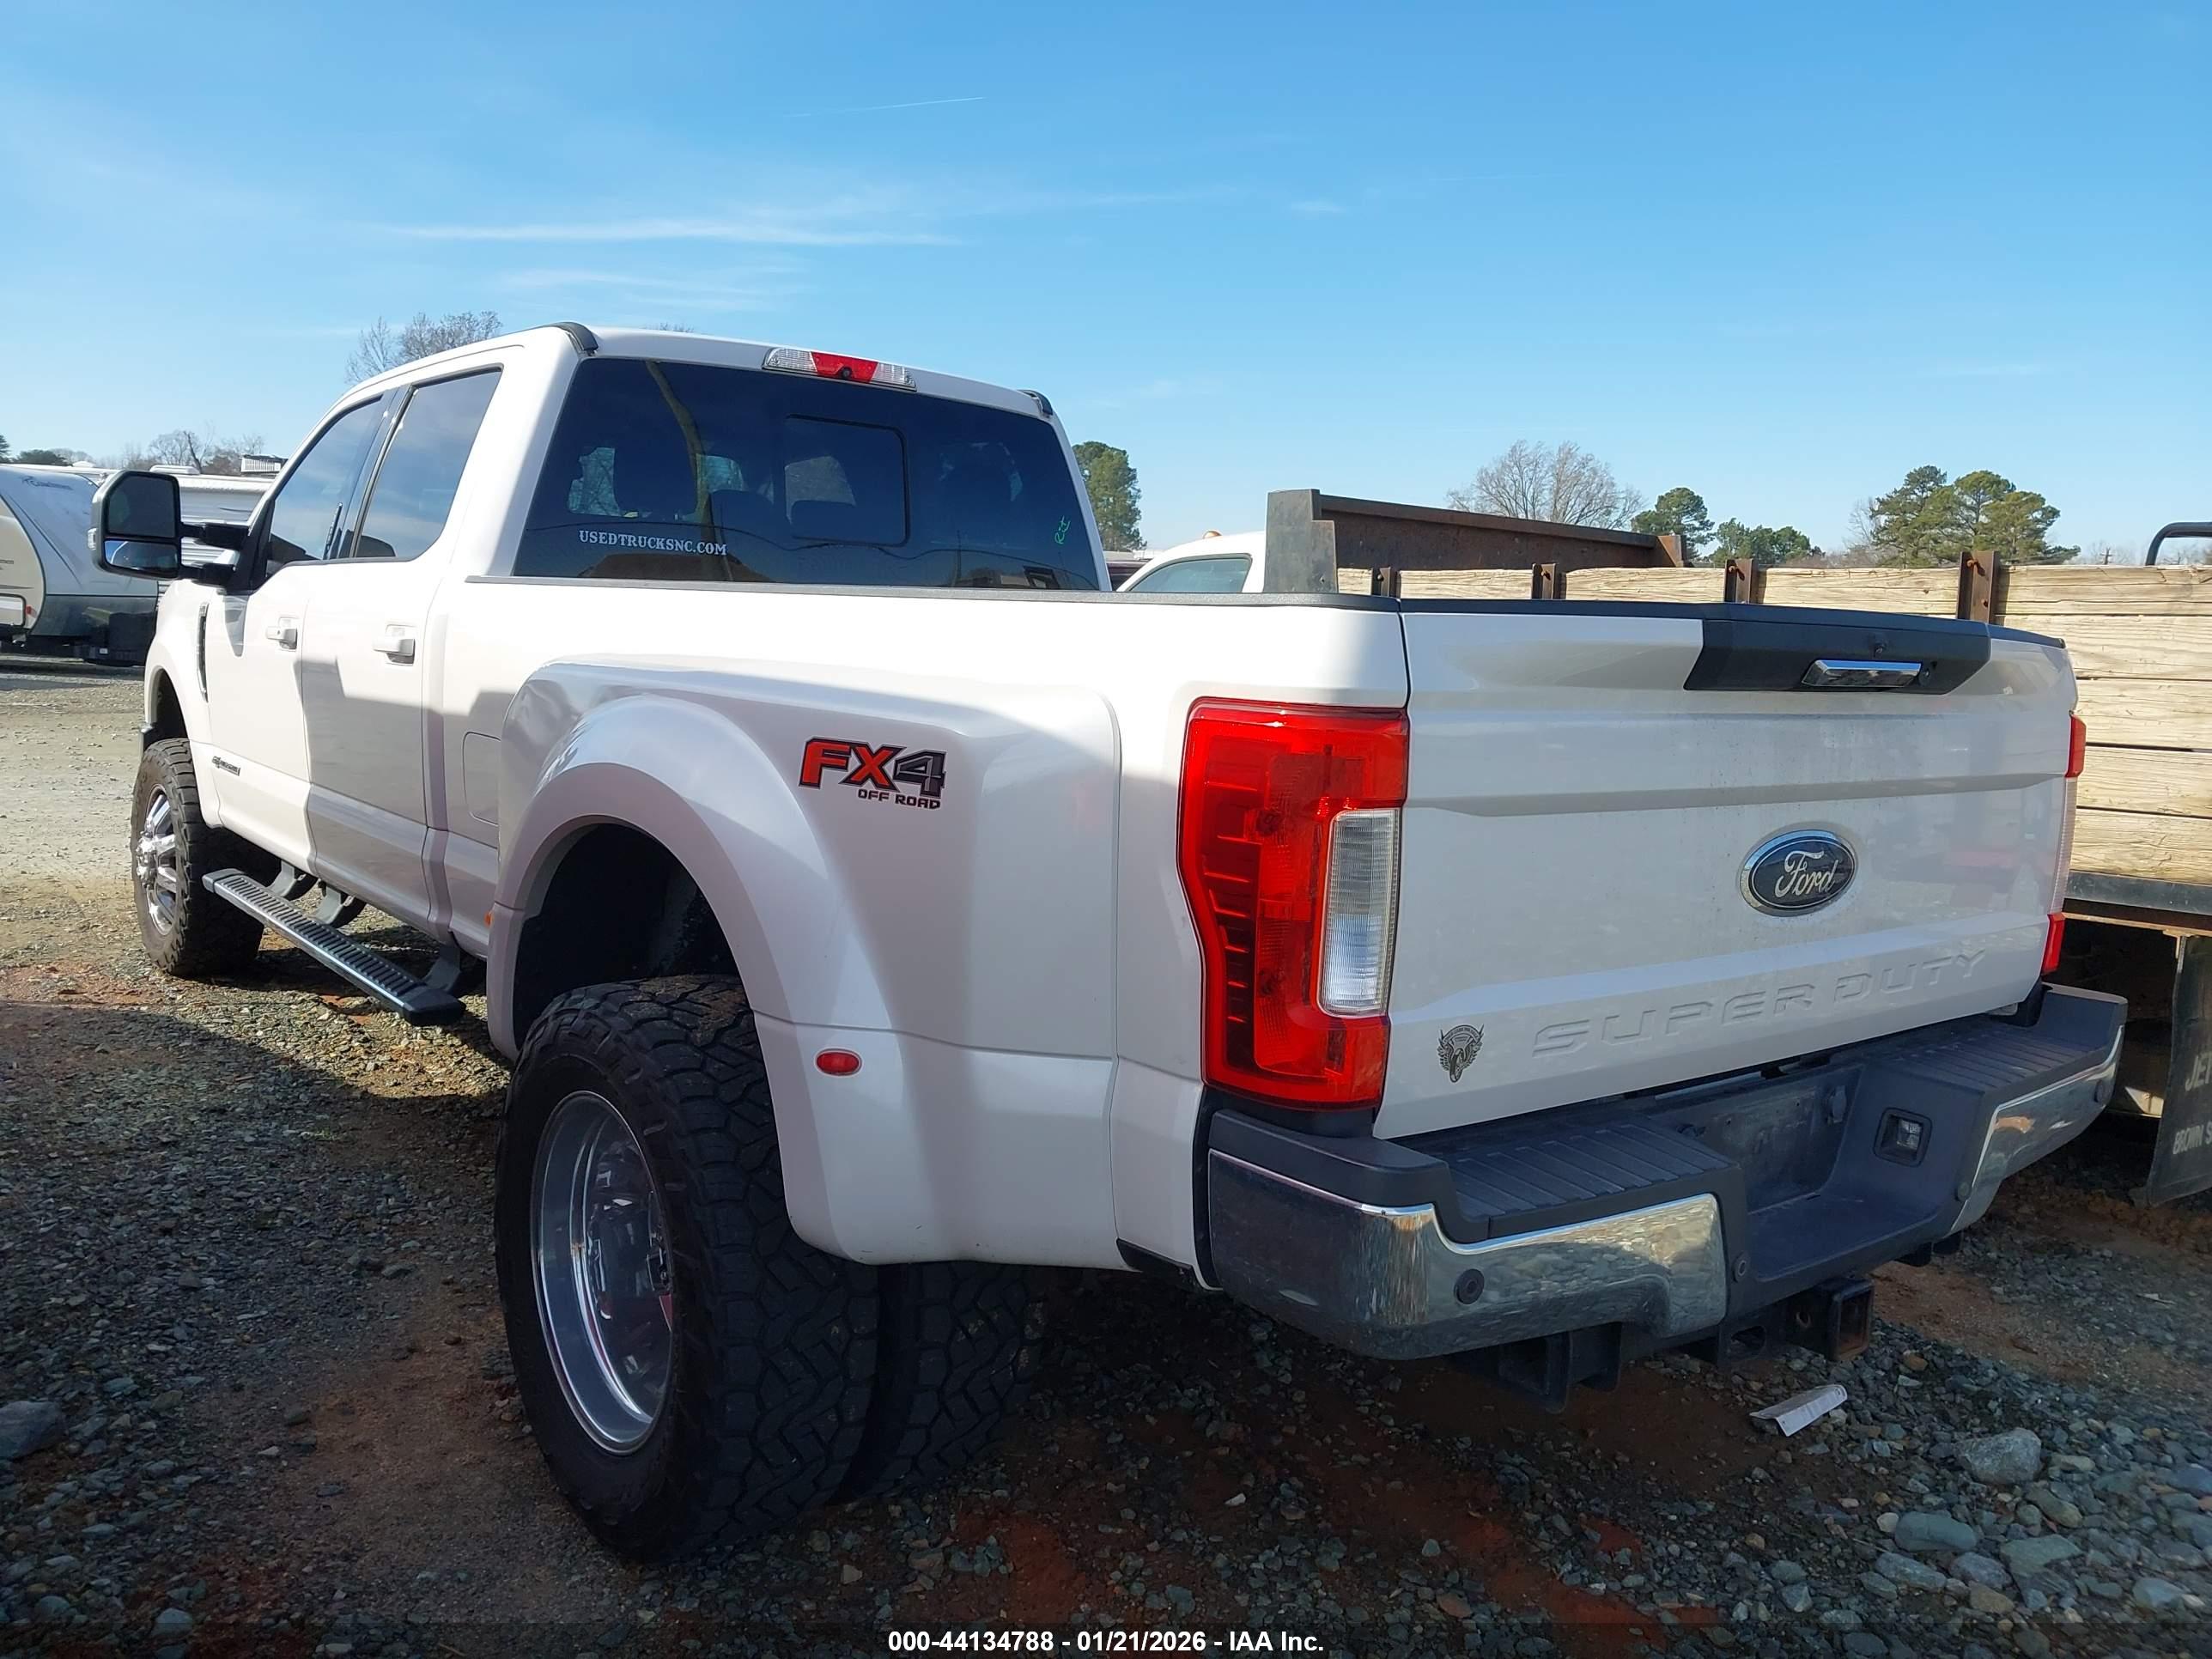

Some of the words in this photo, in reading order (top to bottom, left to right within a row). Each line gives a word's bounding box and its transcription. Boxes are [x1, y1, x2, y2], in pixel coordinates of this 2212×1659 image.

[579, 530, 727, 556] USEDTRUCKSNC.COM
[799, 736, 946, 800] FX4
[858, 789, 890, 802] OFF
[895, 793, 942, 810] ROAD
[1774, 848, 1839, 898] Ford
[1532, 983, 1815, 1059] SUPER
[1833, 945, 1986, 1003] DUTY
